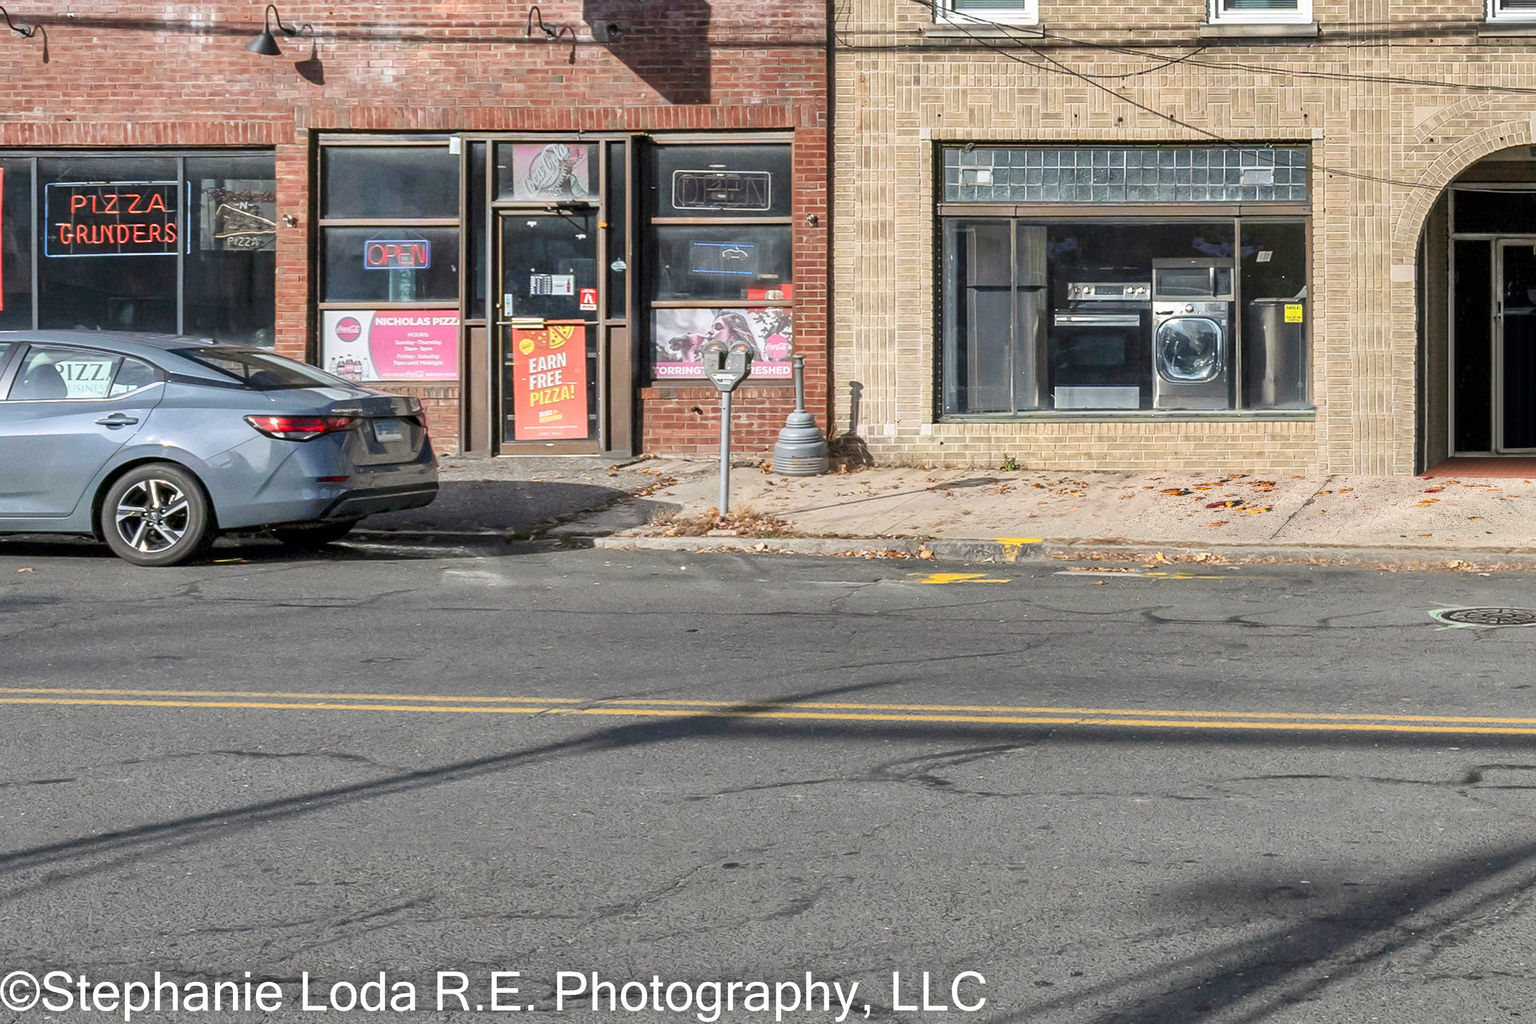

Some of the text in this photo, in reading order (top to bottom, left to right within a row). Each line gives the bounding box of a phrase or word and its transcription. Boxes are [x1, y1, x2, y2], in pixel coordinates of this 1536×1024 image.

[70, 194, 166, 214] PIZZA
[60, 223, 177, 244] GRINDERS
[368, 244, 428, 265] OPEN
[375, 317, 431, 325] NICHOLAS
[57, 364, 110, 380] PIZZ
[529, 352, 567, 374] EARN
[653, 366, 790, 374] TORRING RESHED
[529, 370, 563, 390] FREE
[530, 384, 575, 407] PIZZA!
